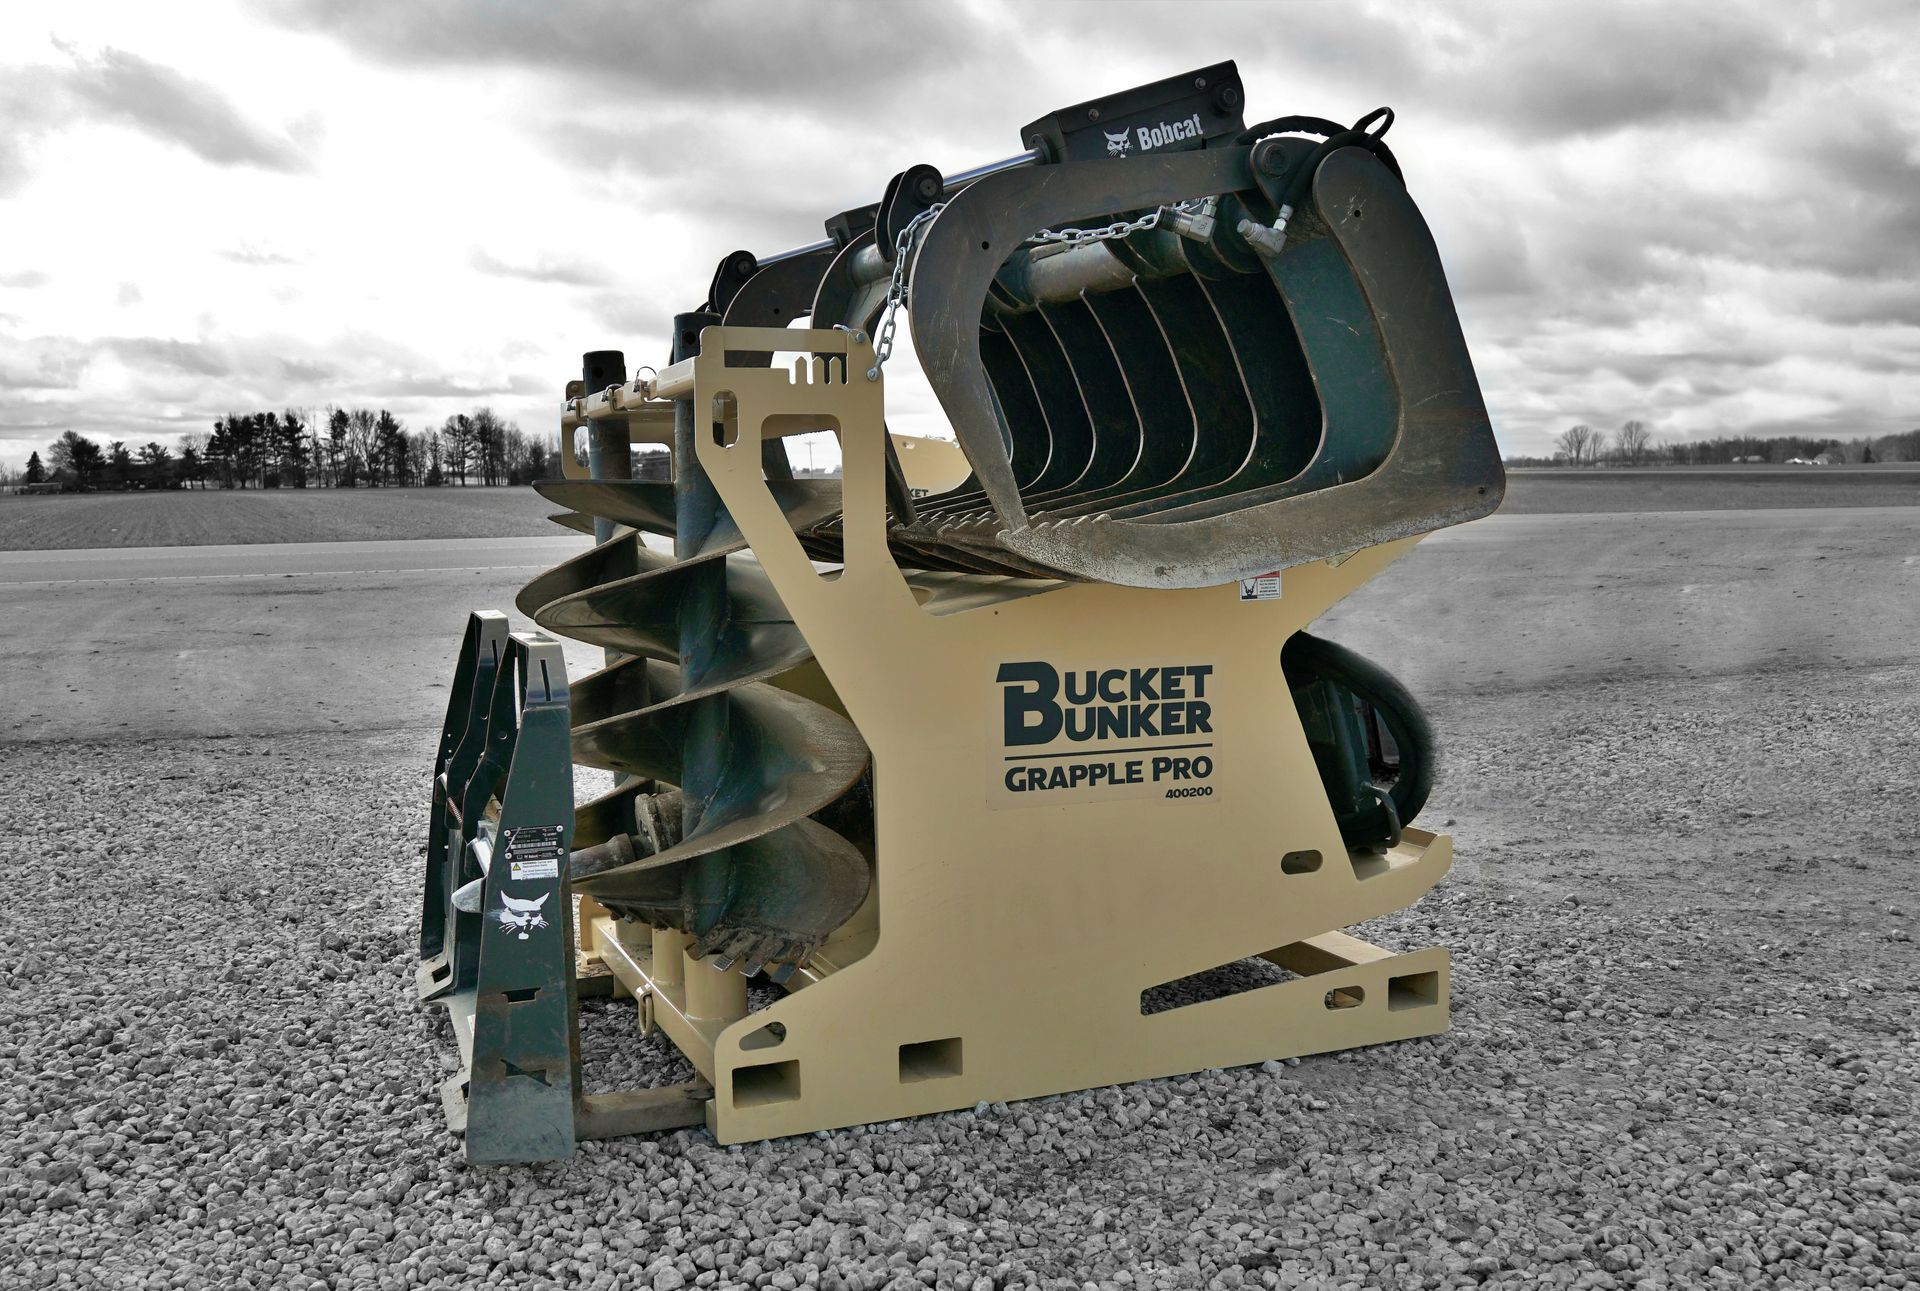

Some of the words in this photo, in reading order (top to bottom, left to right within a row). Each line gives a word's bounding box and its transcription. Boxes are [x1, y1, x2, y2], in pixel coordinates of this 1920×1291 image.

[1136, 113, 1204, 151] Bobcat
[908, 488, 929, 498] KET
[996, 661, 1213, 706] BUCKET
[1004, 700, 1213, 747] BUNKER
[1004, 760, 1144, 792] GRAPPLE
[1152, 755, 1213, 782] PRO
[1165, 786, 1213, 799] 400200
